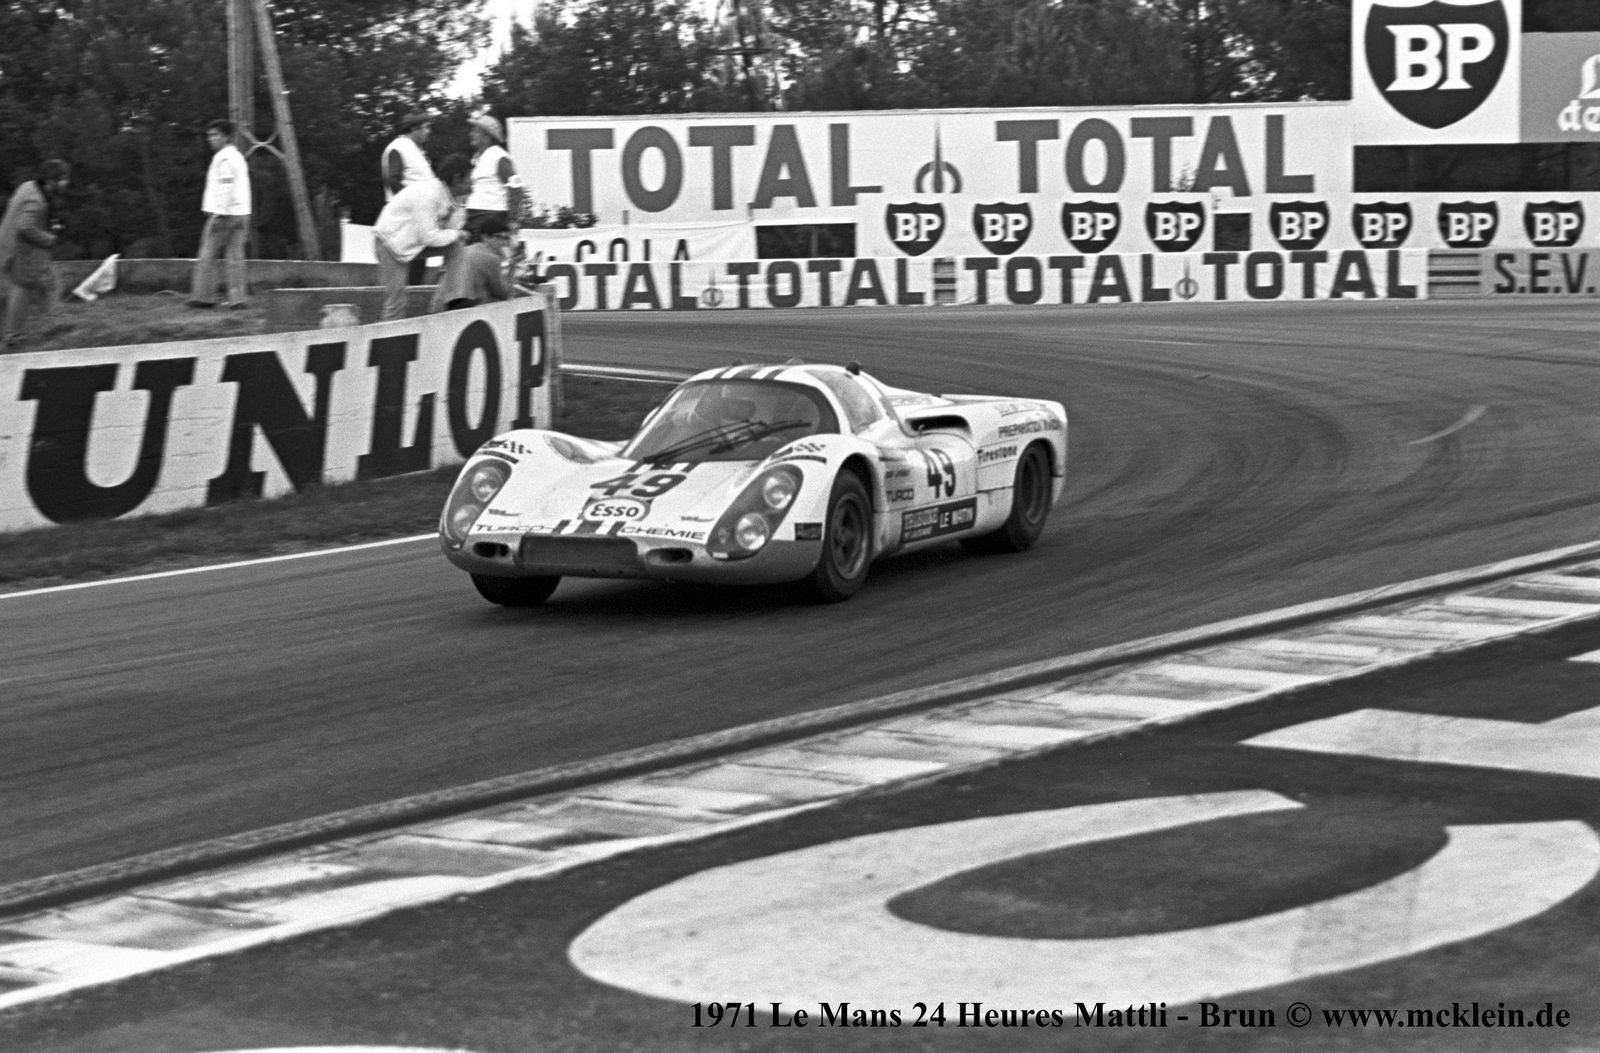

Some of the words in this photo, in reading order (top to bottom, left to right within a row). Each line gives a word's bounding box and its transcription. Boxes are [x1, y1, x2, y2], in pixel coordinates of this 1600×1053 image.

[1385, 23, 1495, 91] BP
[546, 123, 882, 213] TOTAL
[995, 115, 1314, 197] TOTAL
[893, 212, 939, 244] BP
[983, 211, 1028, 243] BP
[1070, 211, 1116, 242] BP
[1155, 211, 1200, 242] BP
[1278, 211, 1324, 242] BP
[1361, 213, 1406, 243] BP
[1448, 212, 1494, 243] BP
[1534, 212, 1580, 242] BP
[546, 262, 698, 309] OTAL
[728, 258, 924, 307] TOTAL
[965, 253, 1170, 305] TOTAL
[1203, 249, 1418, 301] TOTAL
[1493, 252, 1597, 293] S.E.V.
[977, 445, 1018, 465] Firestone
[590, 474, 687, 498] 49
[921, 448, 956, 499] 49
[590, 503, 639, 518] ESSO
[620, 525, 707, 540] CHEMIE
